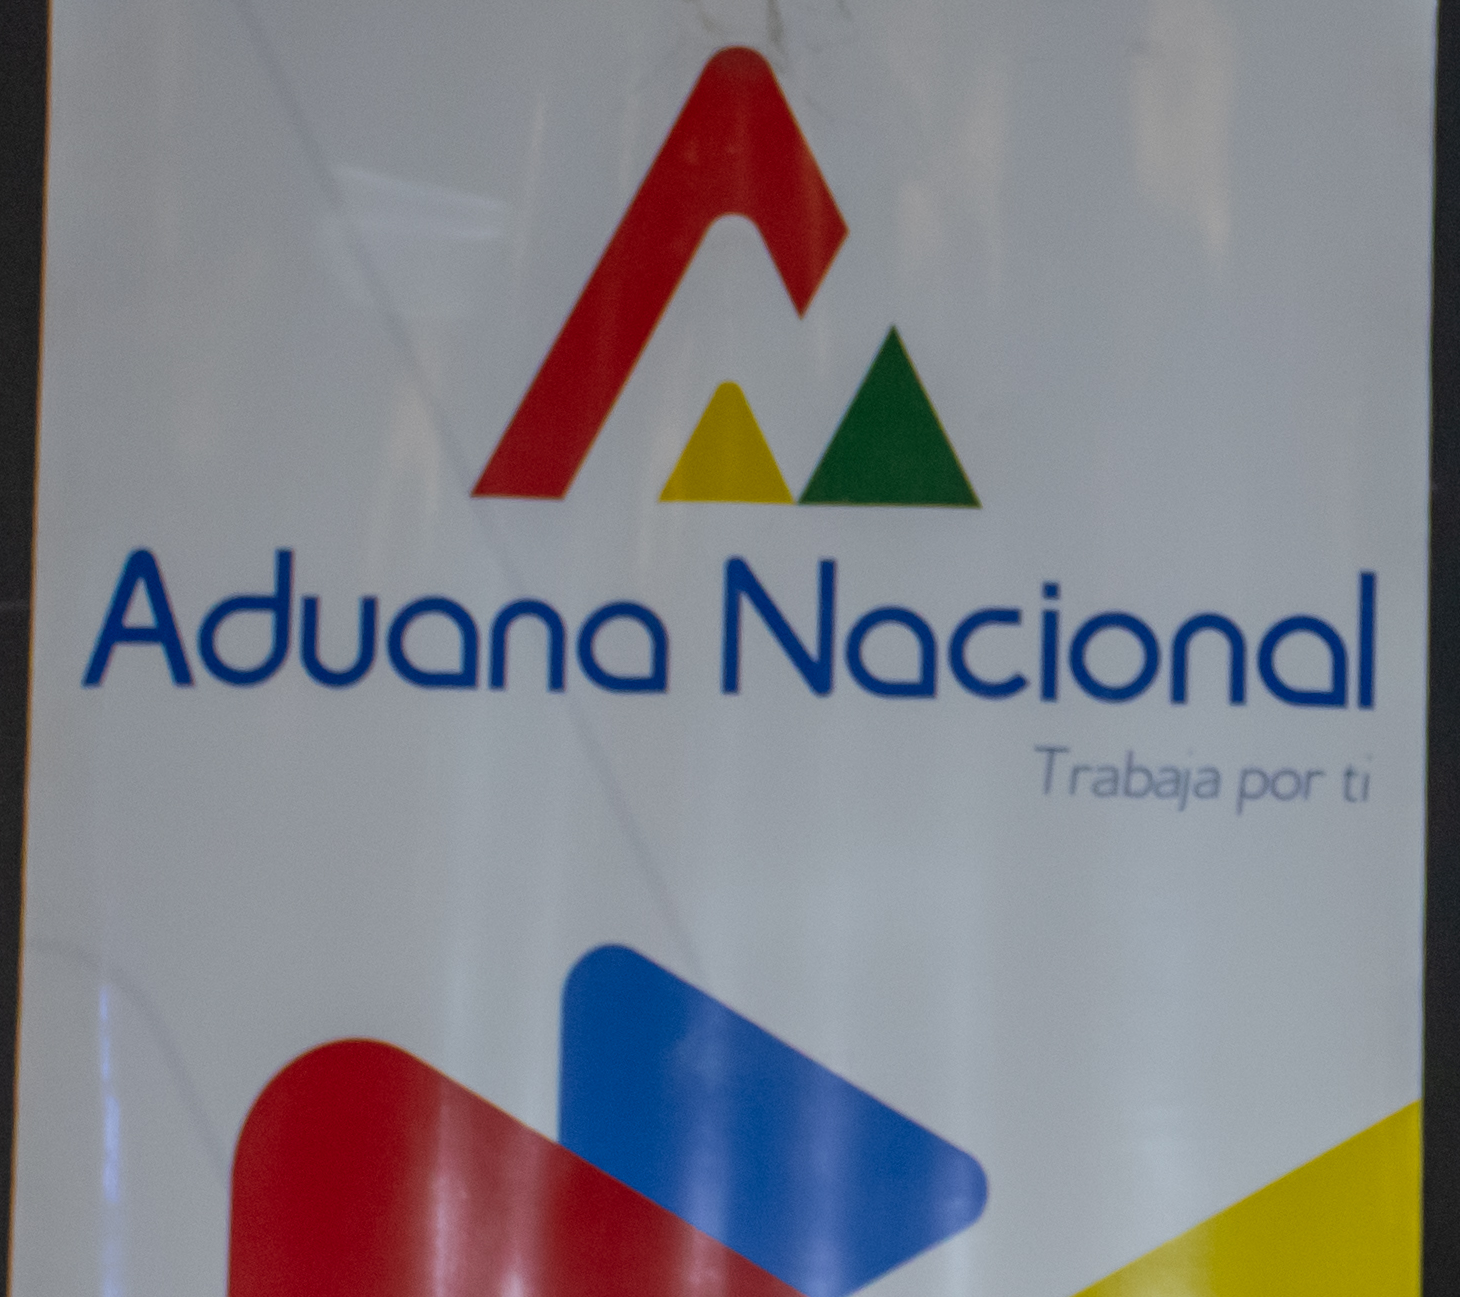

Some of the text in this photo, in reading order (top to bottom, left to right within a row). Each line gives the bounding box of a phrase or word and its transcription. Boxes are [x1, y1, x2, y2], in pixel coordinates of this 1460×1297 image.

[82, 548, 1378, 709] Aduana Nacional
[1034, 745, 1371, 815] Trabaja por ti
